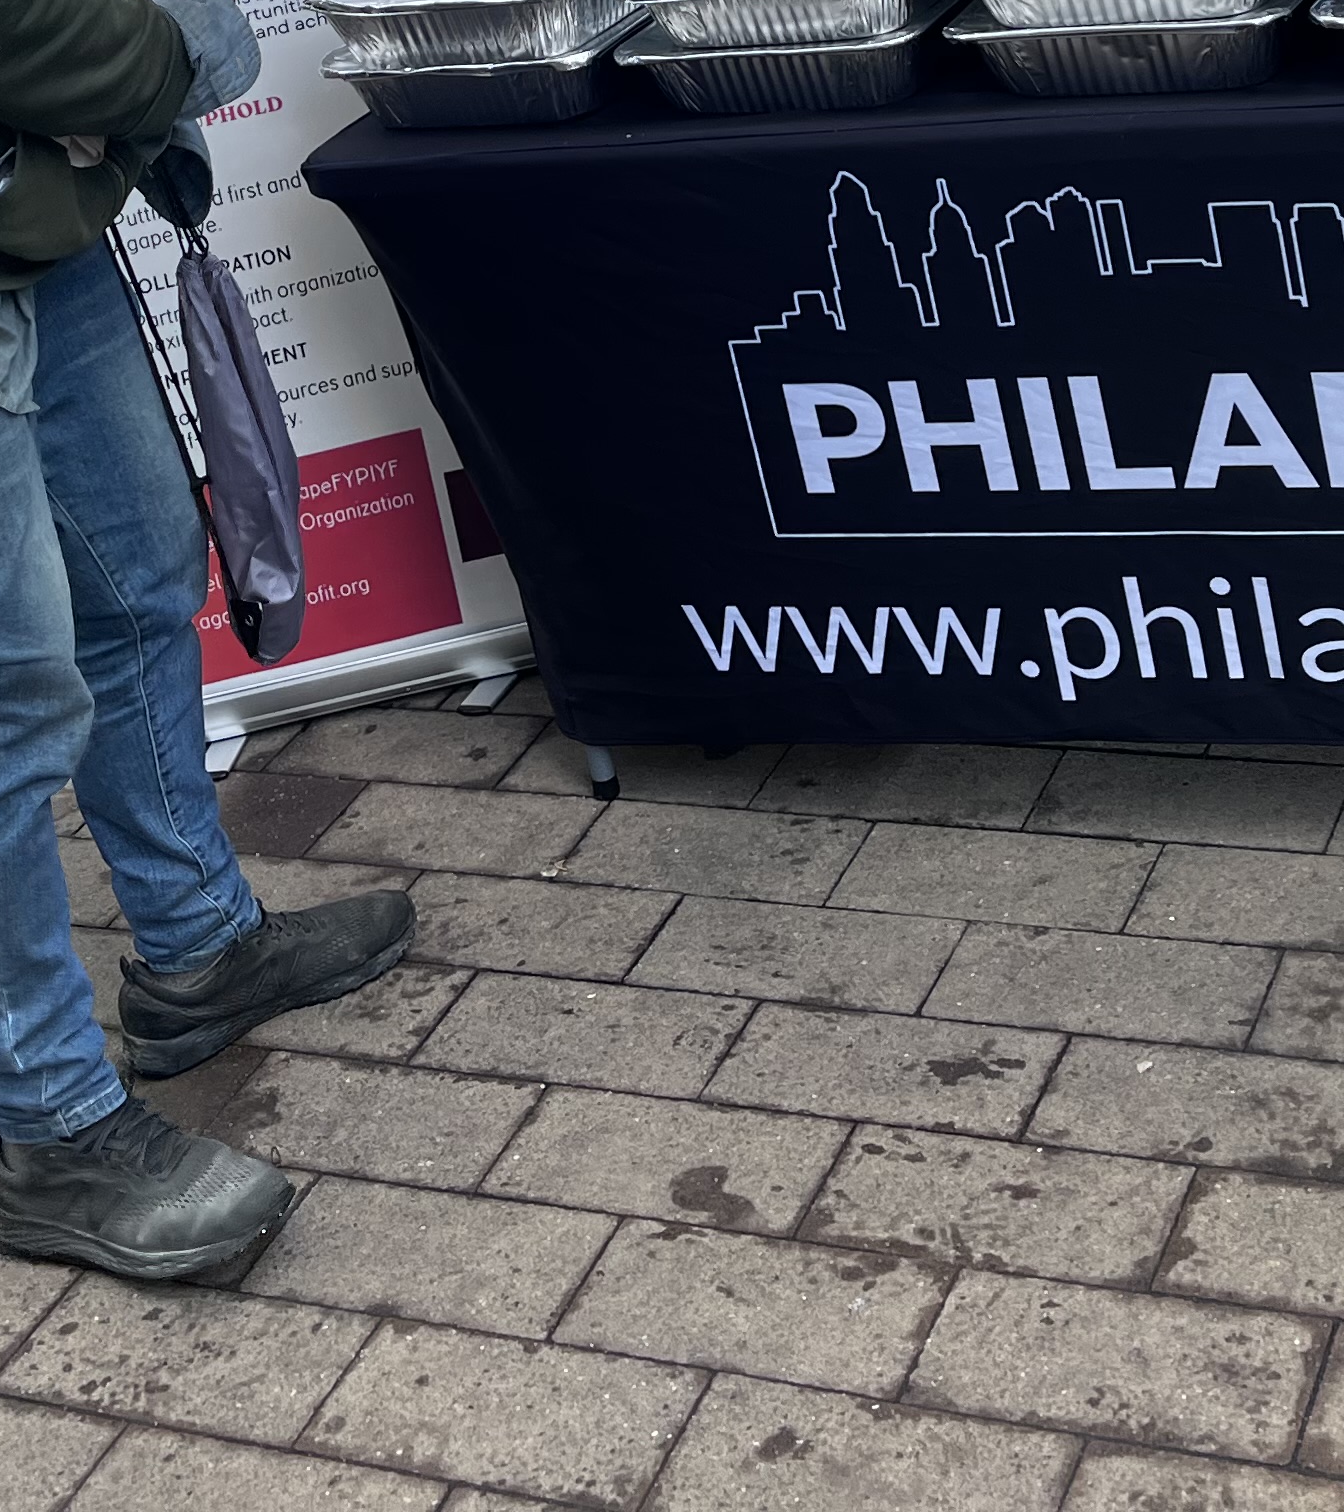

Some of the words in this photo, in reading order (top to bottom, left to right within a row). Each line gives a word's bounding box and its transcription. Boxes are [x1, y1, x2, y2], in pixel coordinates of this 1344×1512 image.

[256, 19, 290, 40] and
[227, 179, 264, 204] first
[267, 170, 303, 195] and
[126, 230, 174, 256] gape
[277, 261, 379, 298] organizatio
[277, 376, 339, 404] ources
[343, 364, 377, 388] and
[299, 459, 398, 501] apeFYPIYF
[300, 492, 415, 531] Organization
[306, 579, 370, 606] ofit.org
